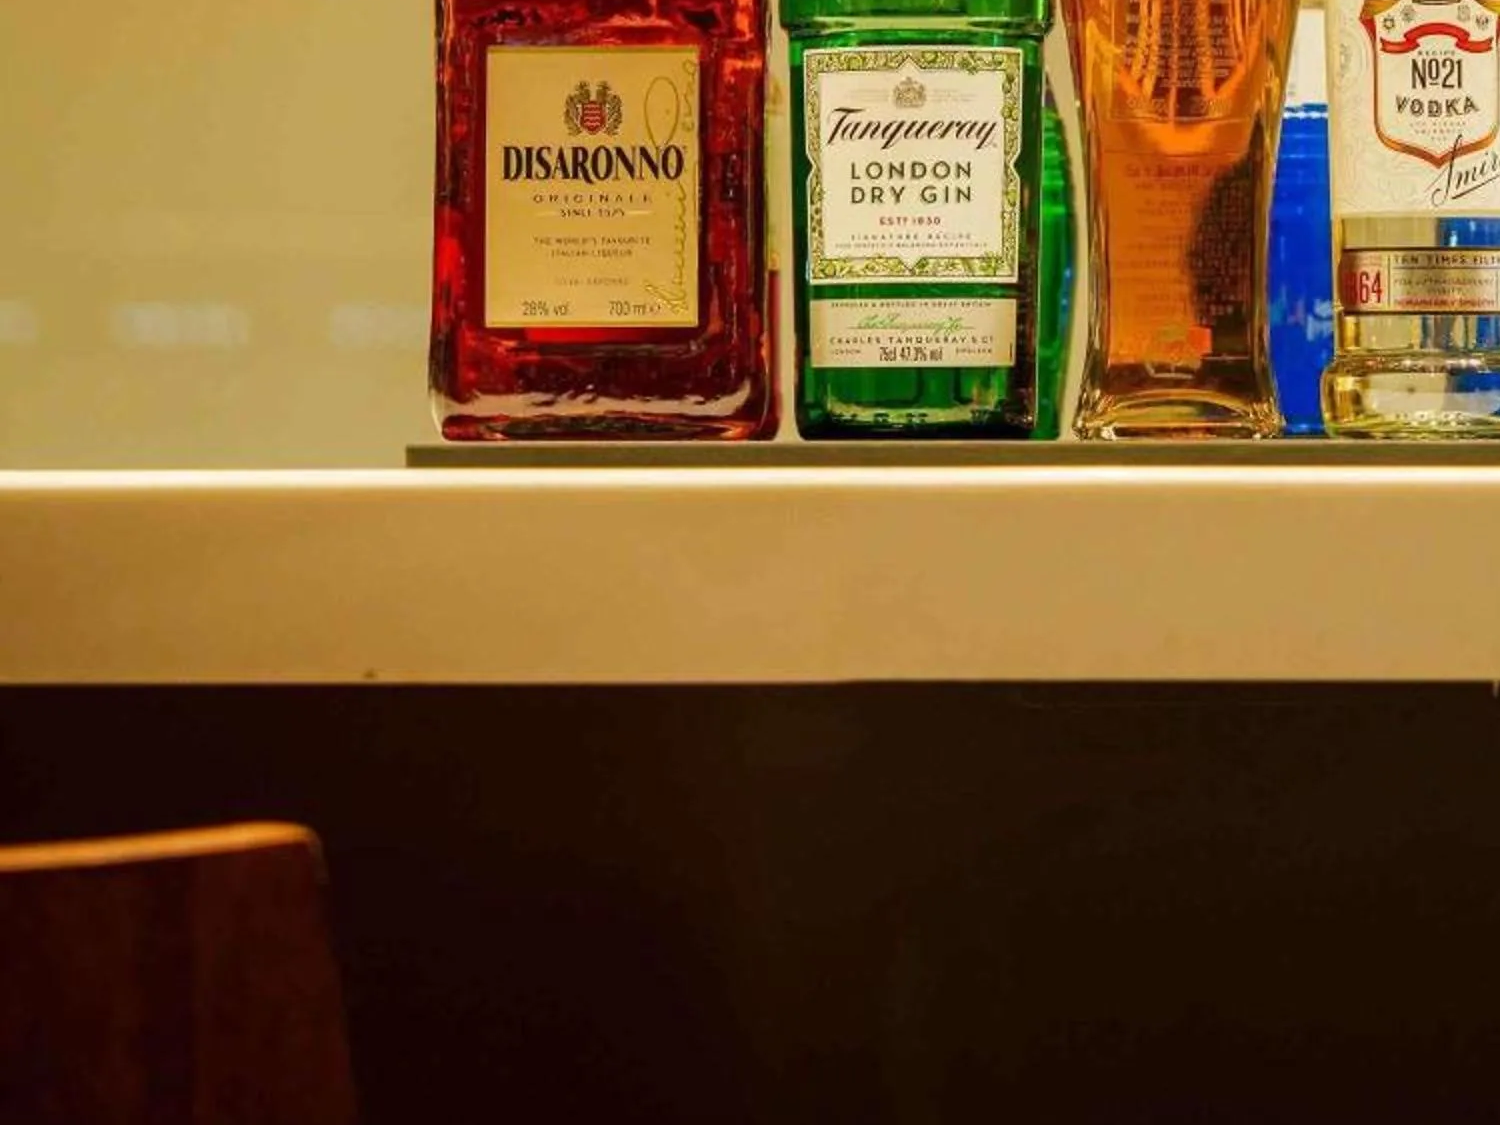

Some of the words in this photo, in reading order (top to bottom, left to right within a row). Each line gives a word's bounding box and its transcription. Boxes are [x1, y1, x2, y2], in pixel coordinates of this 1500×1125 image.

[1395, 95, 1480, 118] VODKA
[827, 107, 998, 150] Tanqueray
[503, 144, 686, 185] DISARONNO
[851, 161, 972, 180] LONDON
[533, 194, 654, 204] ORIGINALE
[851, 185, 905, 205] DRY
[920, 185, 972, 205] GIN
[522, 301, 549, 316] 28%
[609, 300, 631, 316] 700
